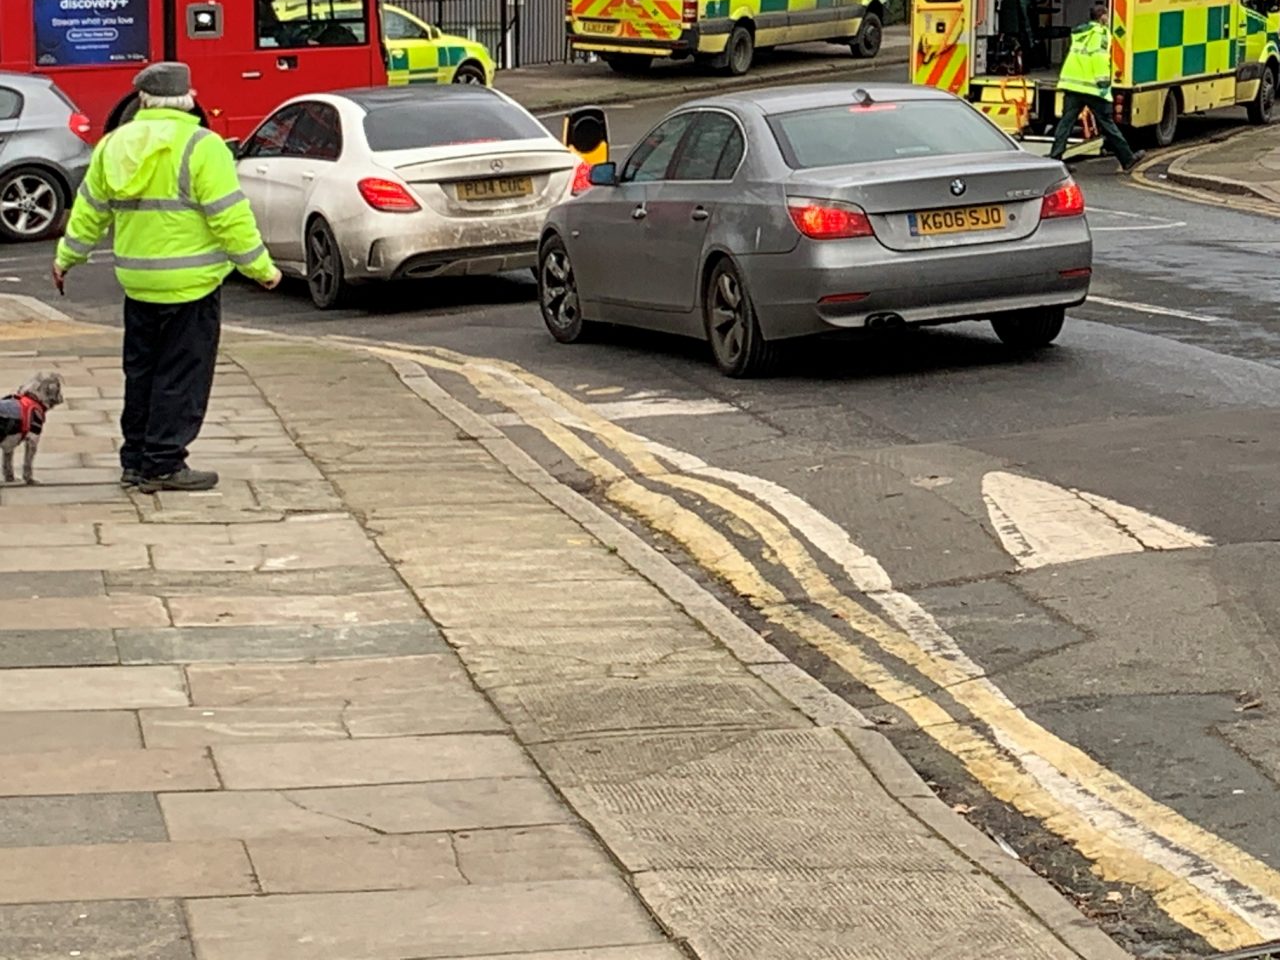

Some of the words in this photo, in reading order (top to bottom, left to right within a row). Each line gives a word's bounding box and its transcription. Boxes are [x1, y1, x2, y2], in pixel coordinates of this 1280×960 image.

[52, 18, 80, 27] Stream
[81, 17, 101, 25] what
[102, 17, 117, 26] you
[117, 16, 134, 25] love
[920, 208, 965, 231] KG06
[968, 206, 1002, 226] SJO
